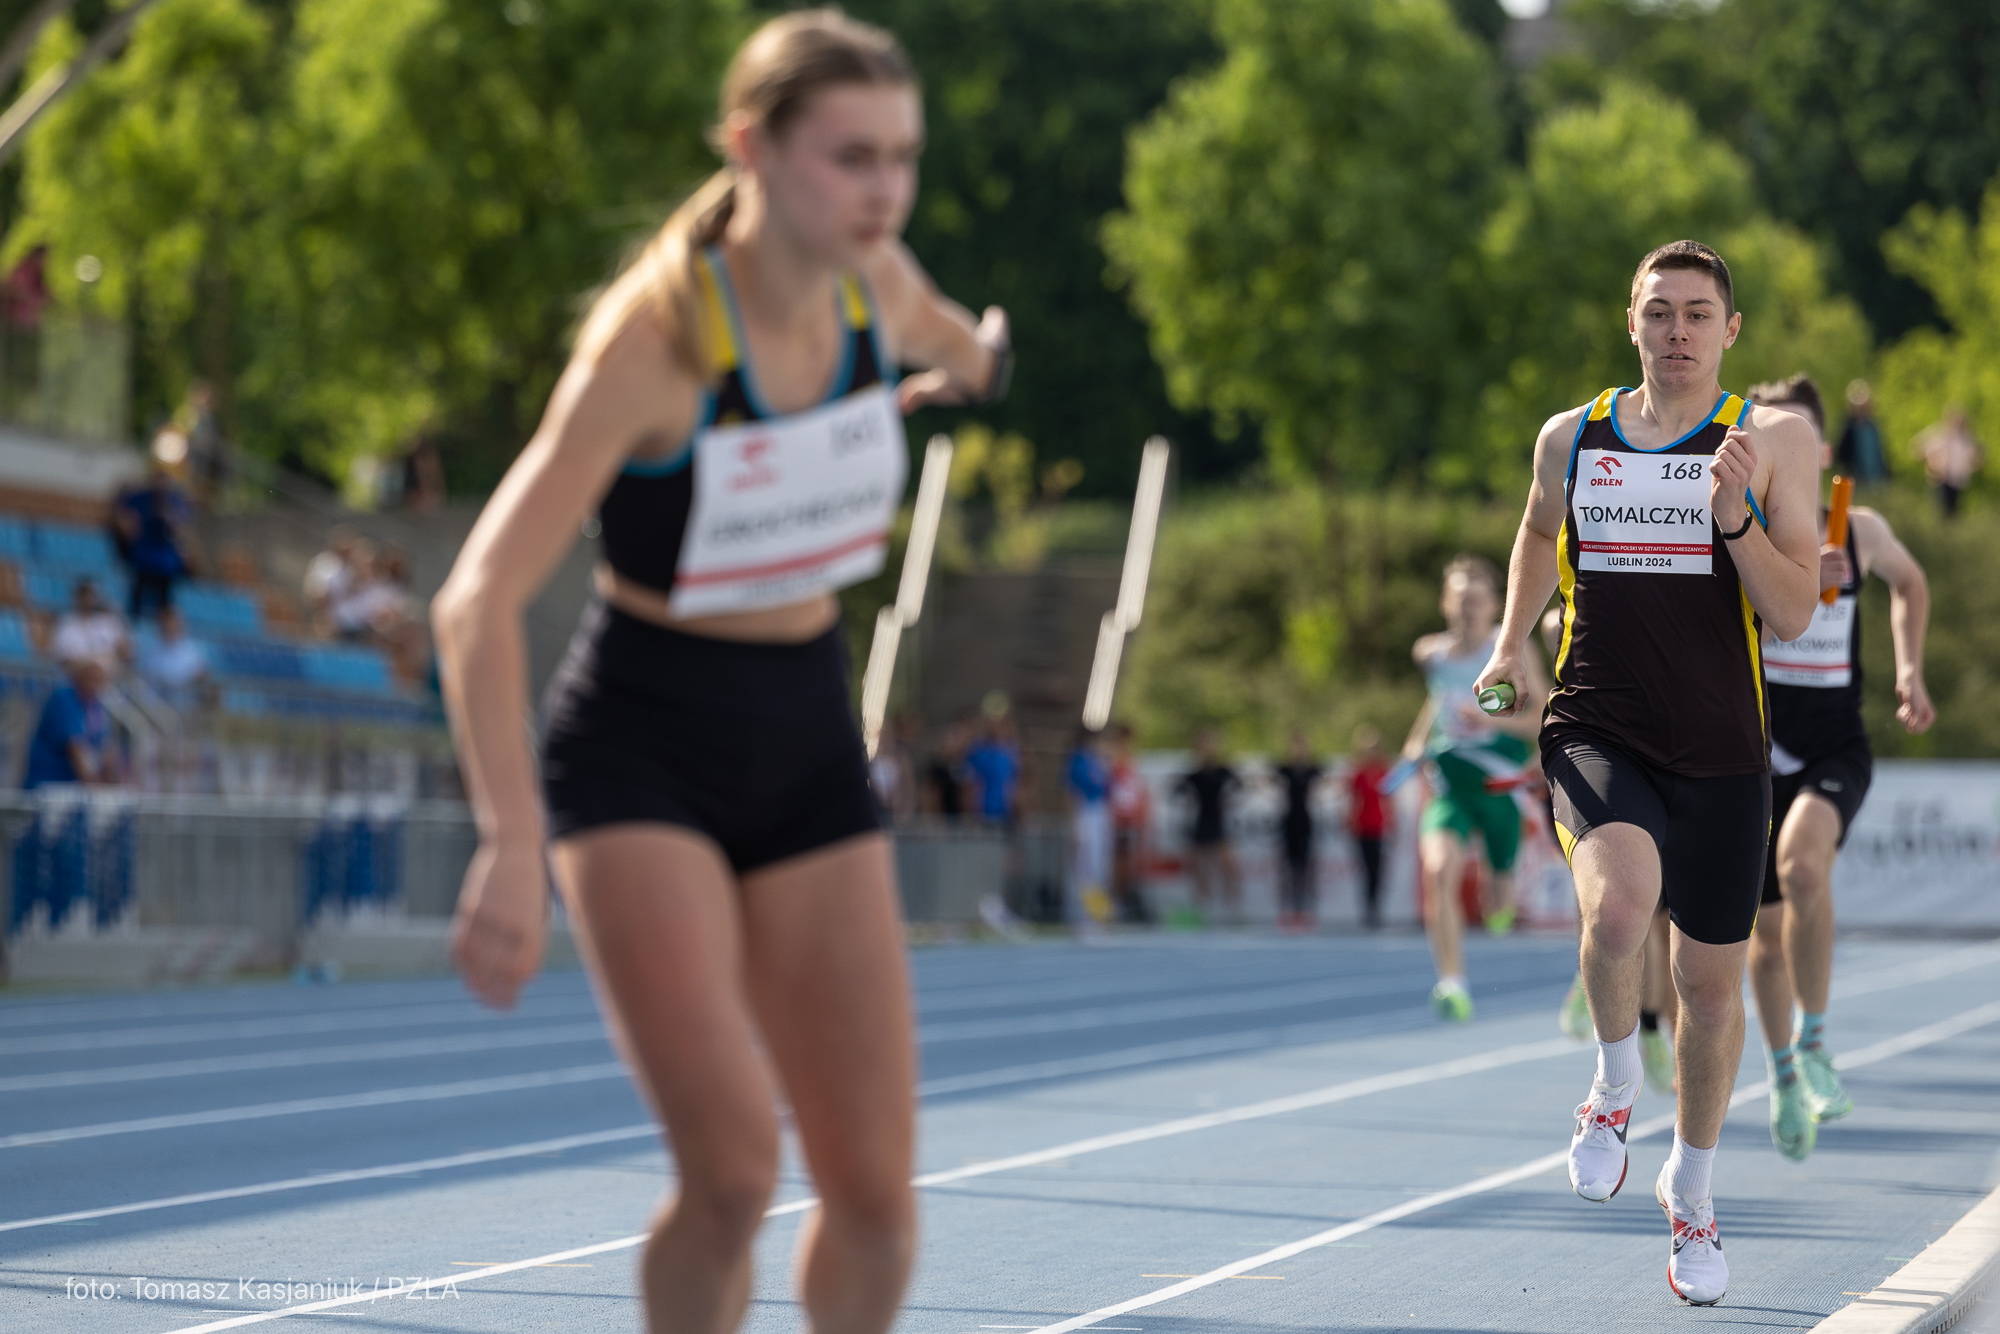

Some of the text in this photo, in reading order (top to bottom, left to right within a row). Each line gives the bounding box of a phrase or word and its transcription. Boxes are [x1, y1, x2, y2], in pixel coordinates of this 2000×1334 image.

[1660, 462, 1702, 480] 168
[1590, 478, 1623, 487] ORLEN
[1579, 506, 1704, 525] TOMALCZYK
[1607, 557, 1672, 567] LUBLIN 2024
